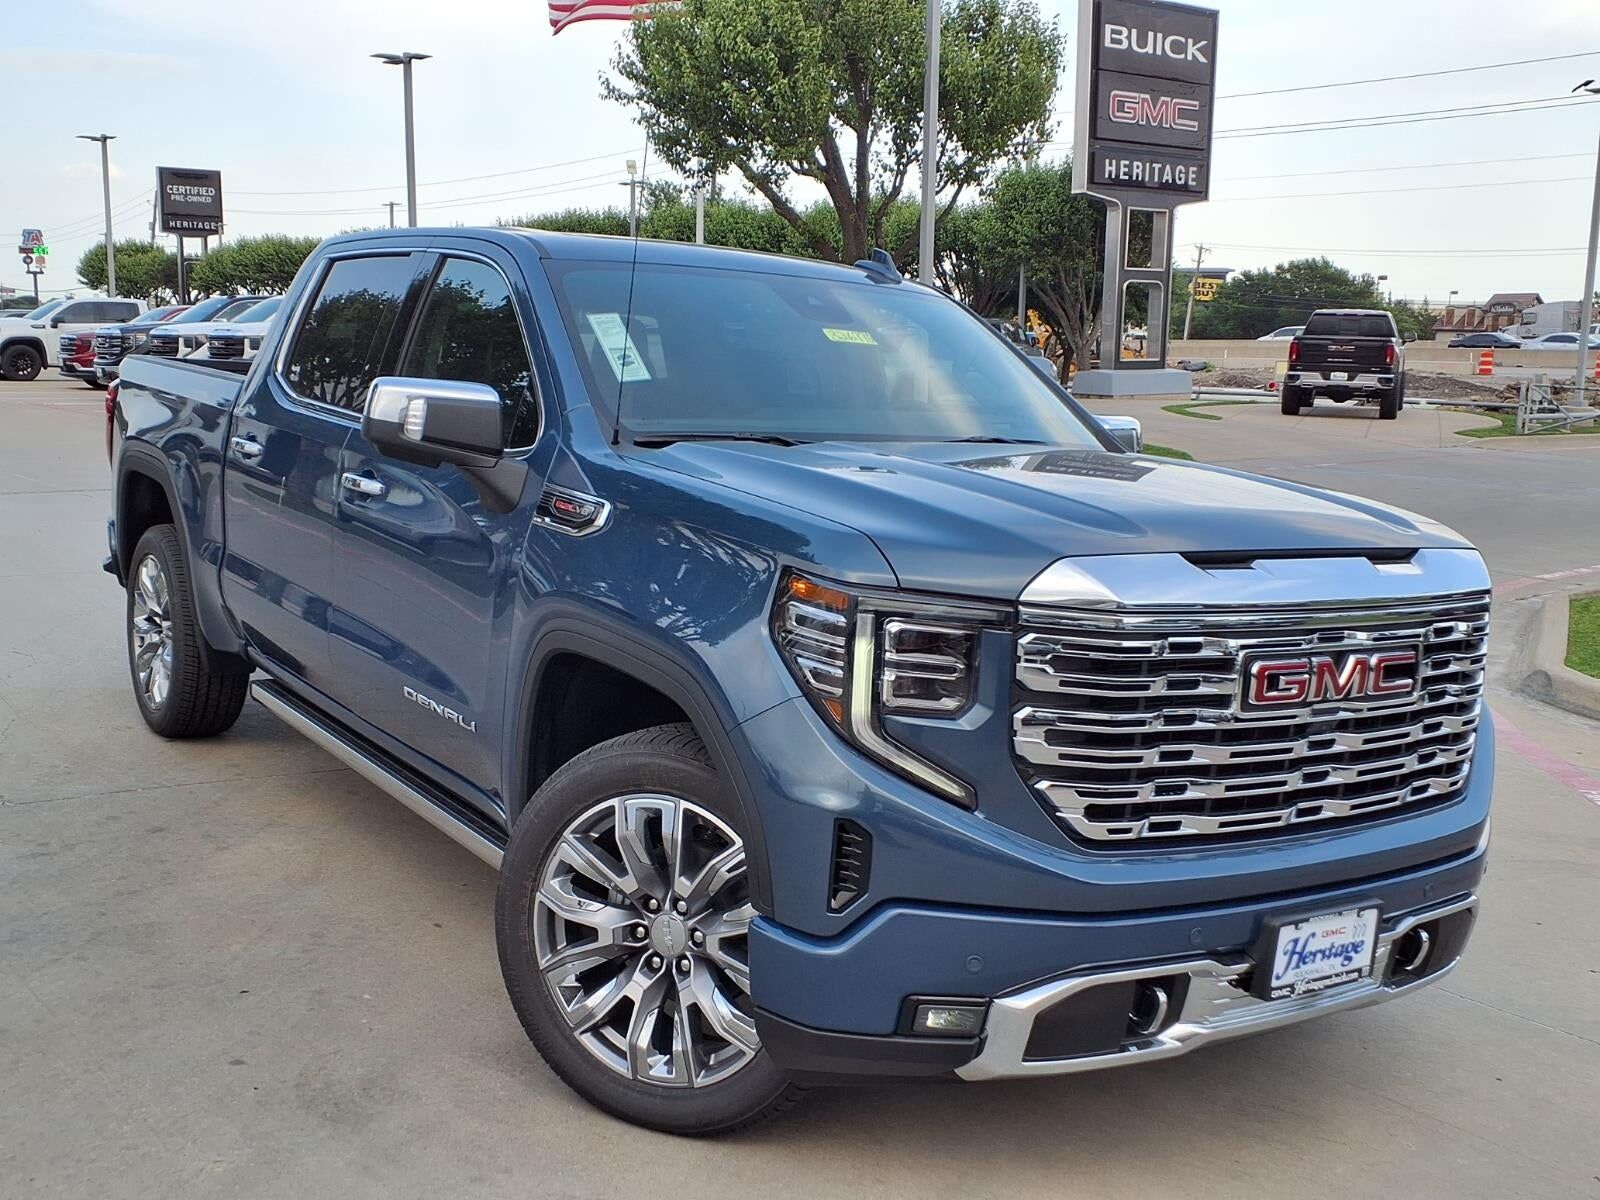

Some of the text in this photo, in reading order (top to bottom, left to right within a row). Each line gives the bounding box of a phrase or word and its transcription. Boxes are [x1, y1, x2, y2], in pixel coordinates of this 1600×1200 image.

[1104, 24, 1208, 63] BUICK
[1109, 90, 1199, 131] GMC
[1104, 158, 1197, 186] HERITAGE
[166, 184, 216, 196] CERTIFIED
[171, 194, 212, 203] PRE-OWNED
[169, 220, 217, 230] HERITAGE
[1249, 651, 1416, 705] GMC
[403, 686, 476, 734] DENALI
[1321, 926, 1347, 938] GMC
[1274, 932, 1365, 980] Heritage
